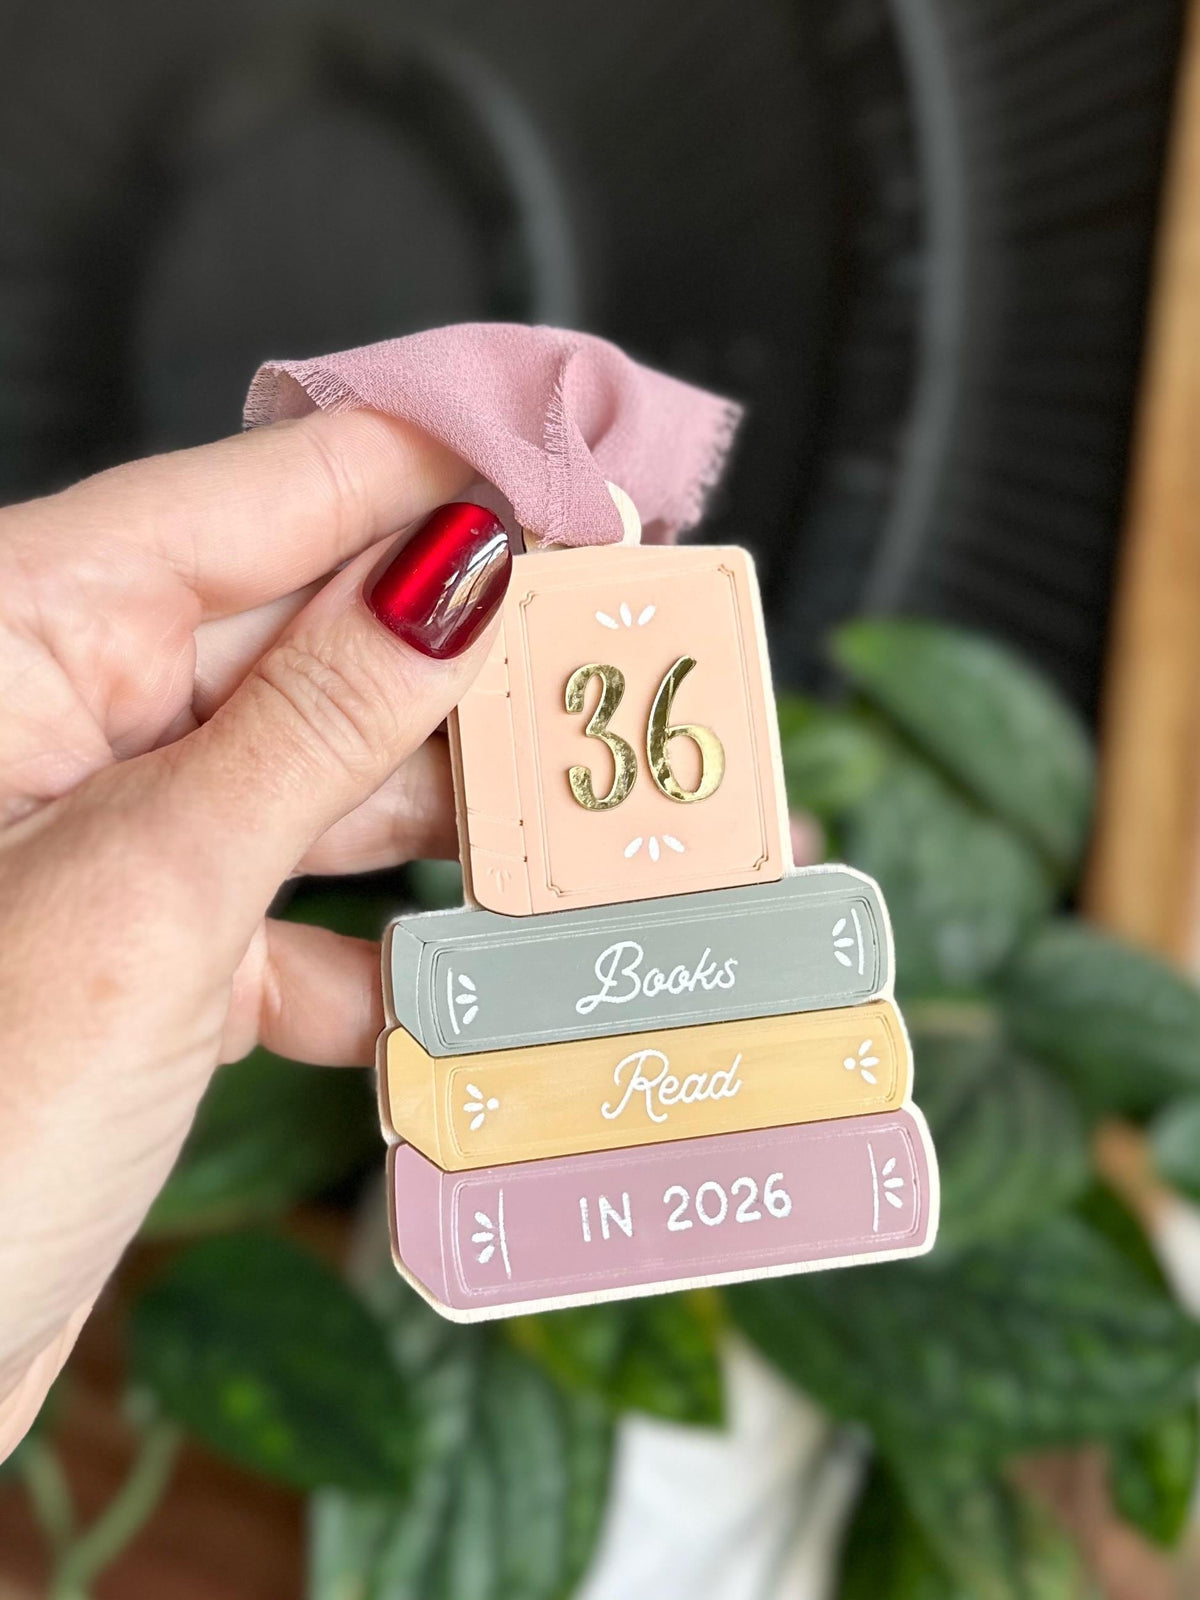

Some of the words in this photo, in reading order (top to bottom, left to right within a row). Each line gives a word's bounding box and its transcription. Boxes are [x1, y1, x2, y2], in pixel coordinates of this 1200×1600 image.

[563, 654, 725, 812] 36
[575, 940, 739, 1015] Books
[600, 1047, 744, 1124] Read
[579, 1191, 633, 1243] IN
[662, 1171, 793, 1232] 2026
